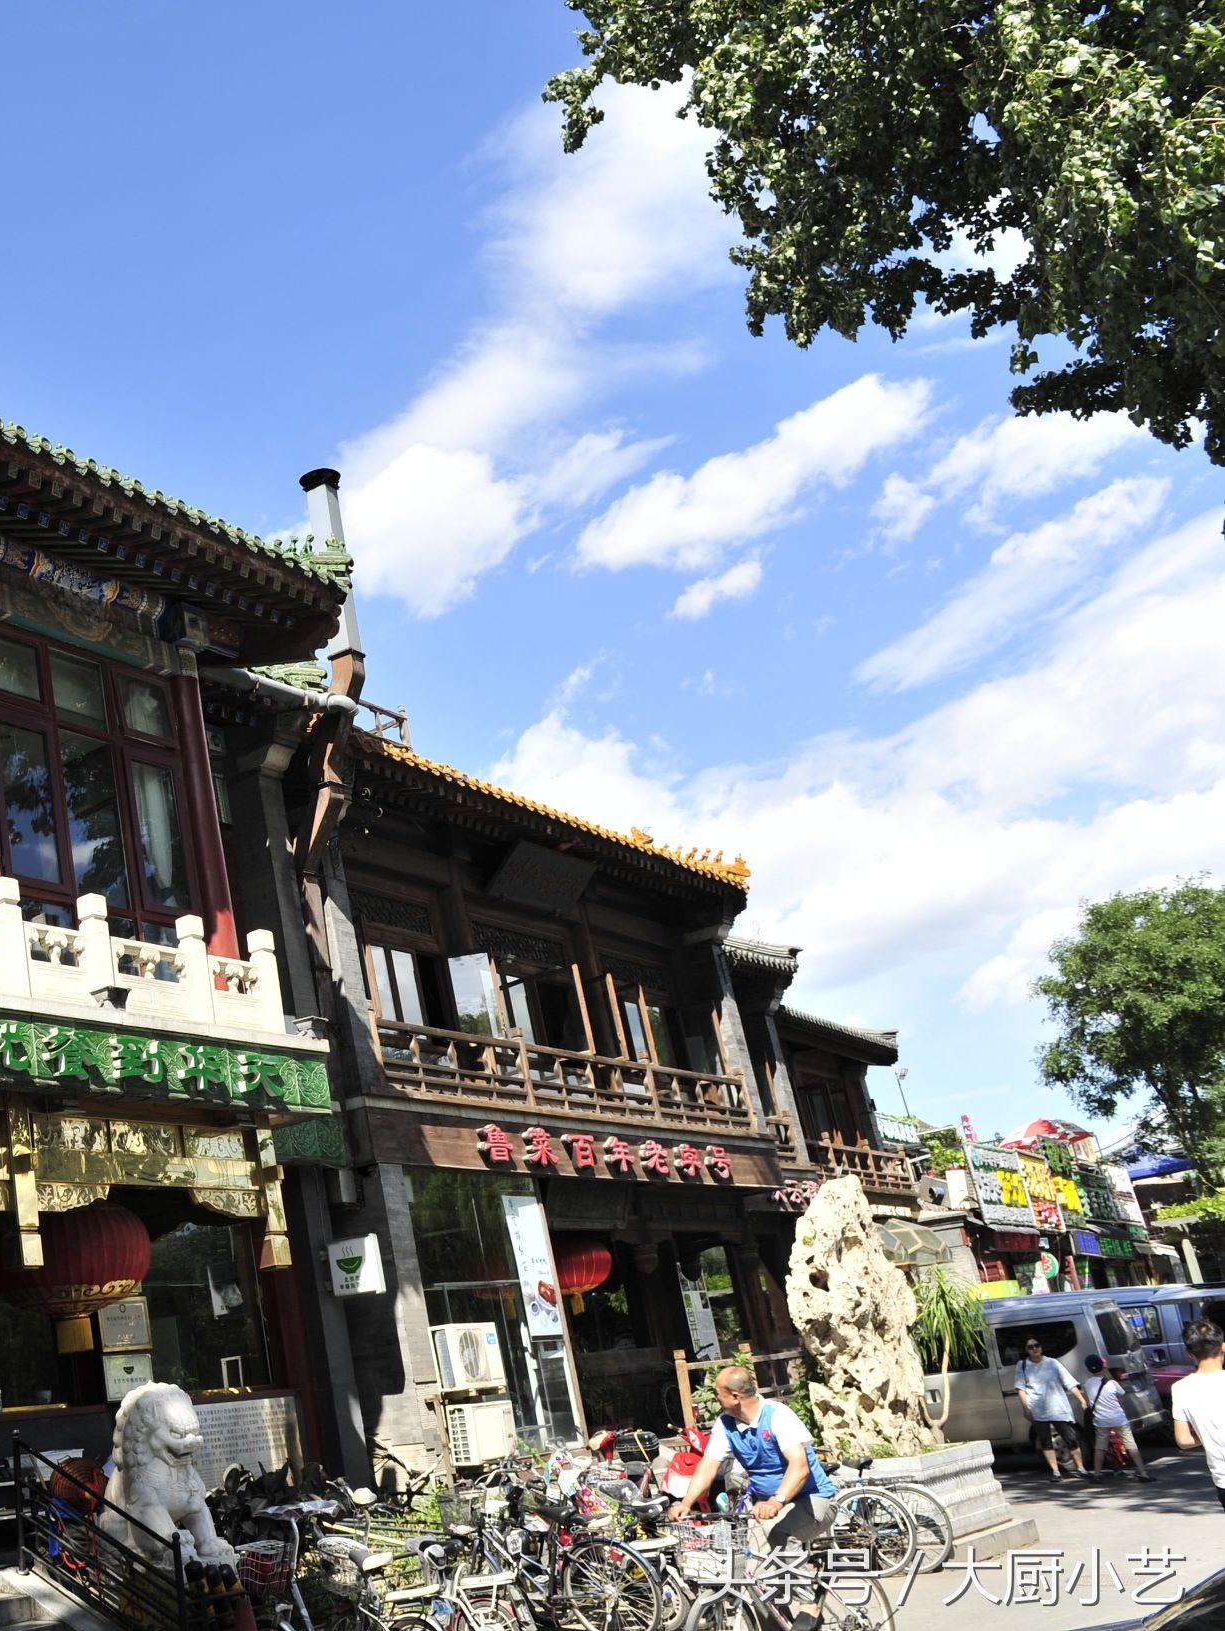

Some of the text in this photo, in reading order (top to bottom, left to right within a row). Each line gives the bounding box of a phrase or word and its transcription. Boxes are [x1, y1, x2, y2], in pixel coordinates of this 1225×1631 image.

[476, 1123, 733, 1179] 鲁菜百年老字号
